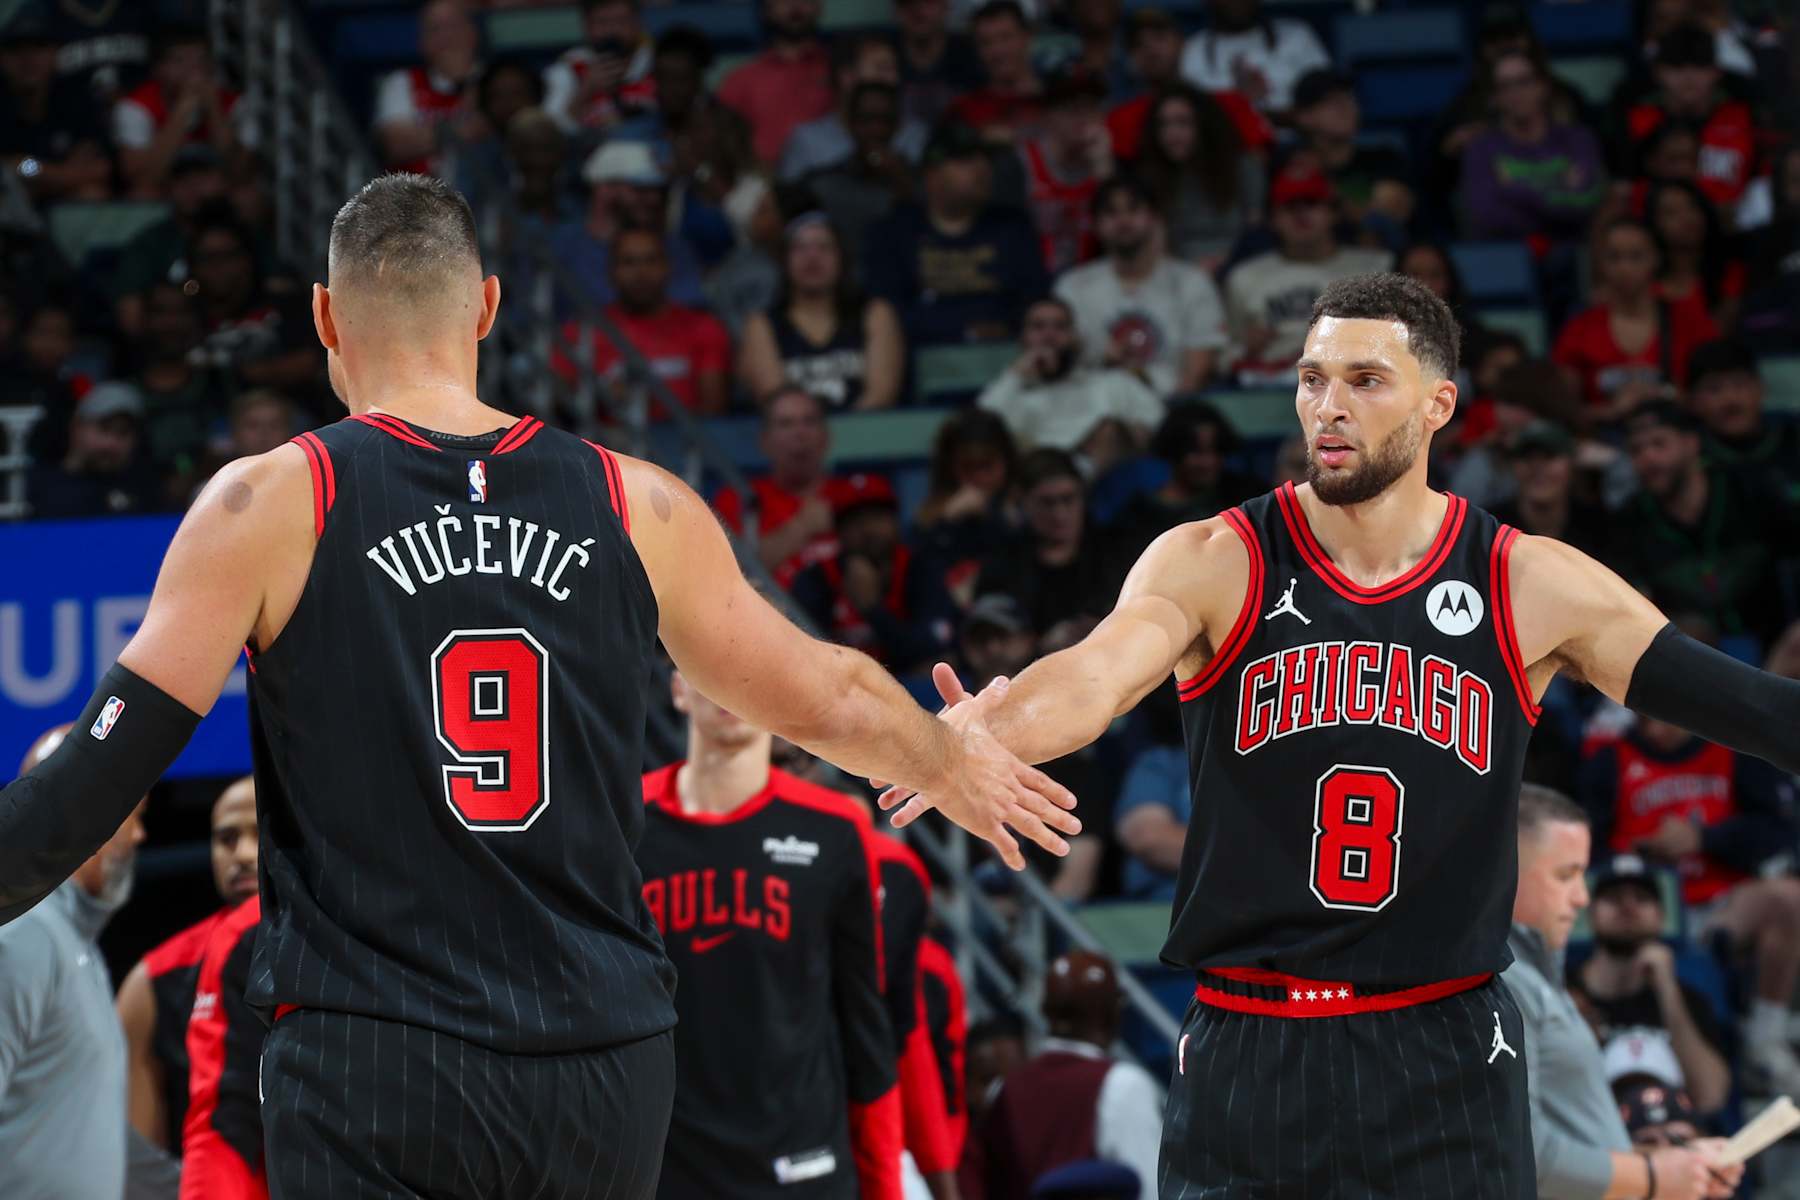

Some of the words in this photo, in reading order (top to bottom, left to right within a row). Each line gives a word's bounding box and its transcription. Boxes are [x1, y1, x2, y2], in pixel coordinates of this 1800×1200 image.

[366, 503, 596, 601] VUČEVIĆ
[430, 627, 550, 832] 9
[1234, 640, 1493, 776] CHICAGO
[1309, 763, 1405, 912] 8
